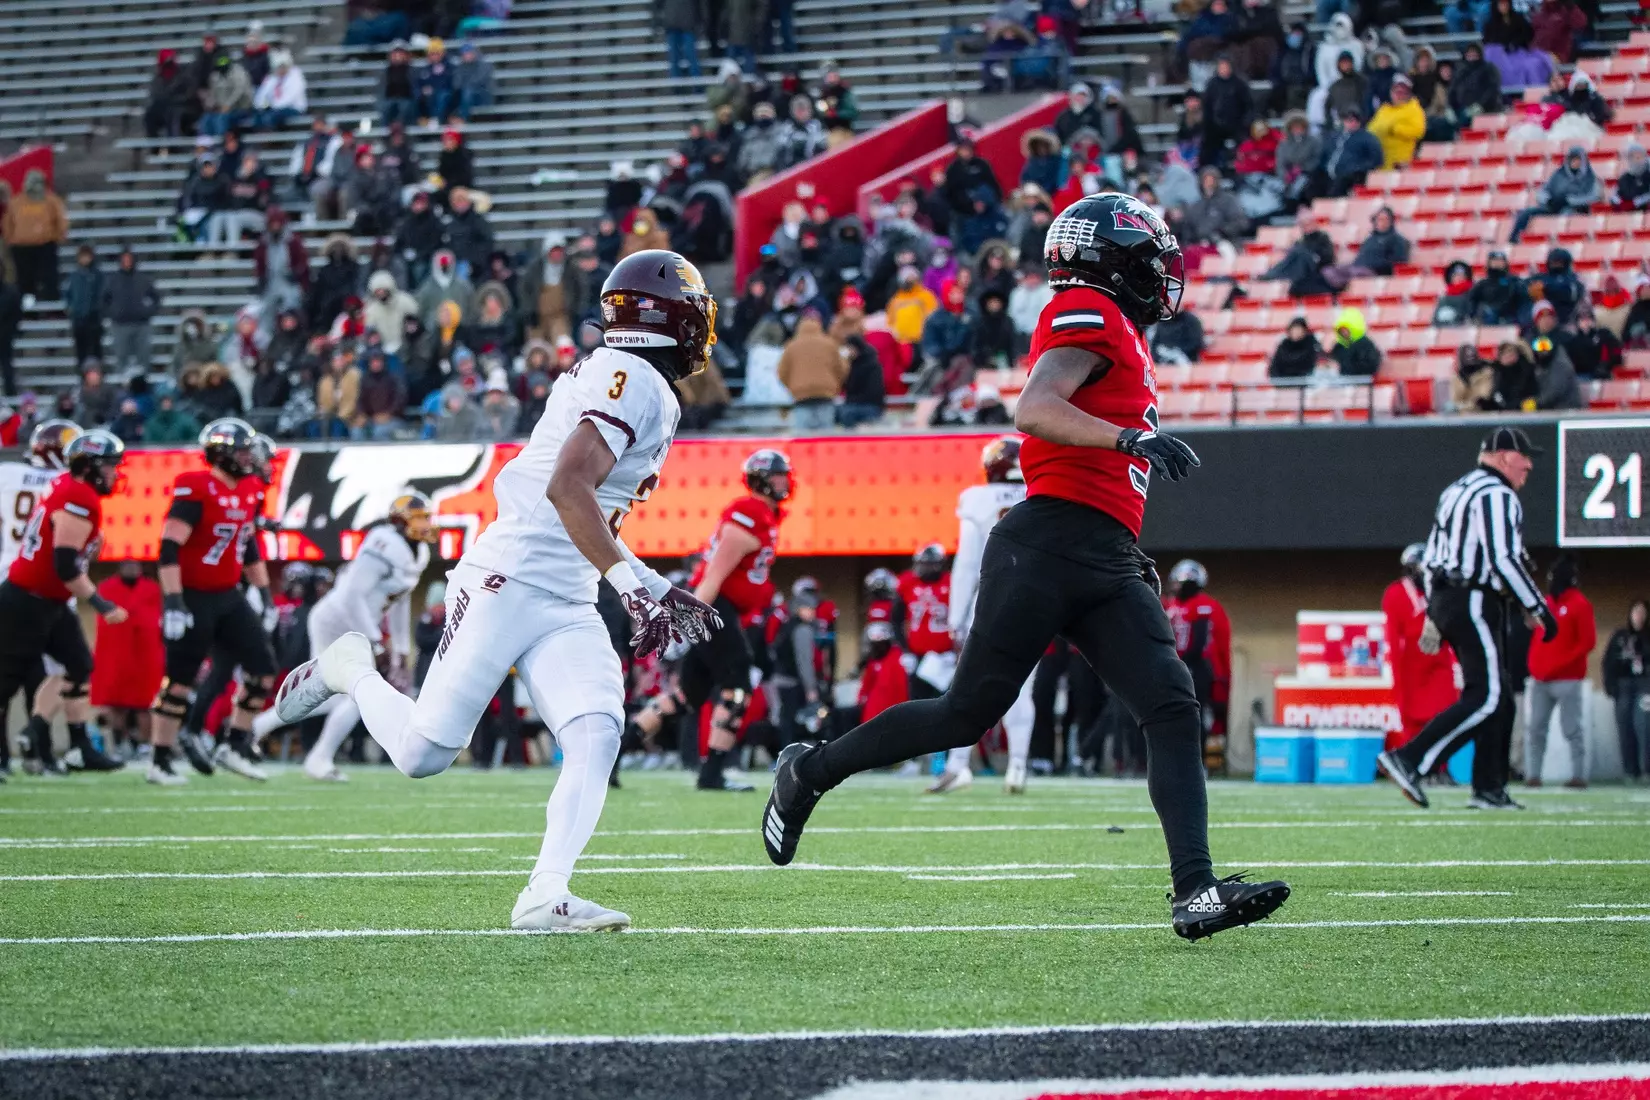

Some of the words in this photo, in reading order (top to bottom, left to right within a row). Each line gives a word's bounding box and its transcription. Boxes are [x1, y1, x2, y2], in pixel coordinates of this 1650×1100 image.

[608, 370, 628, 400] 3
[1583, 452, 1642, 519] 21
[1187, 901, 1228, 913] adidas
